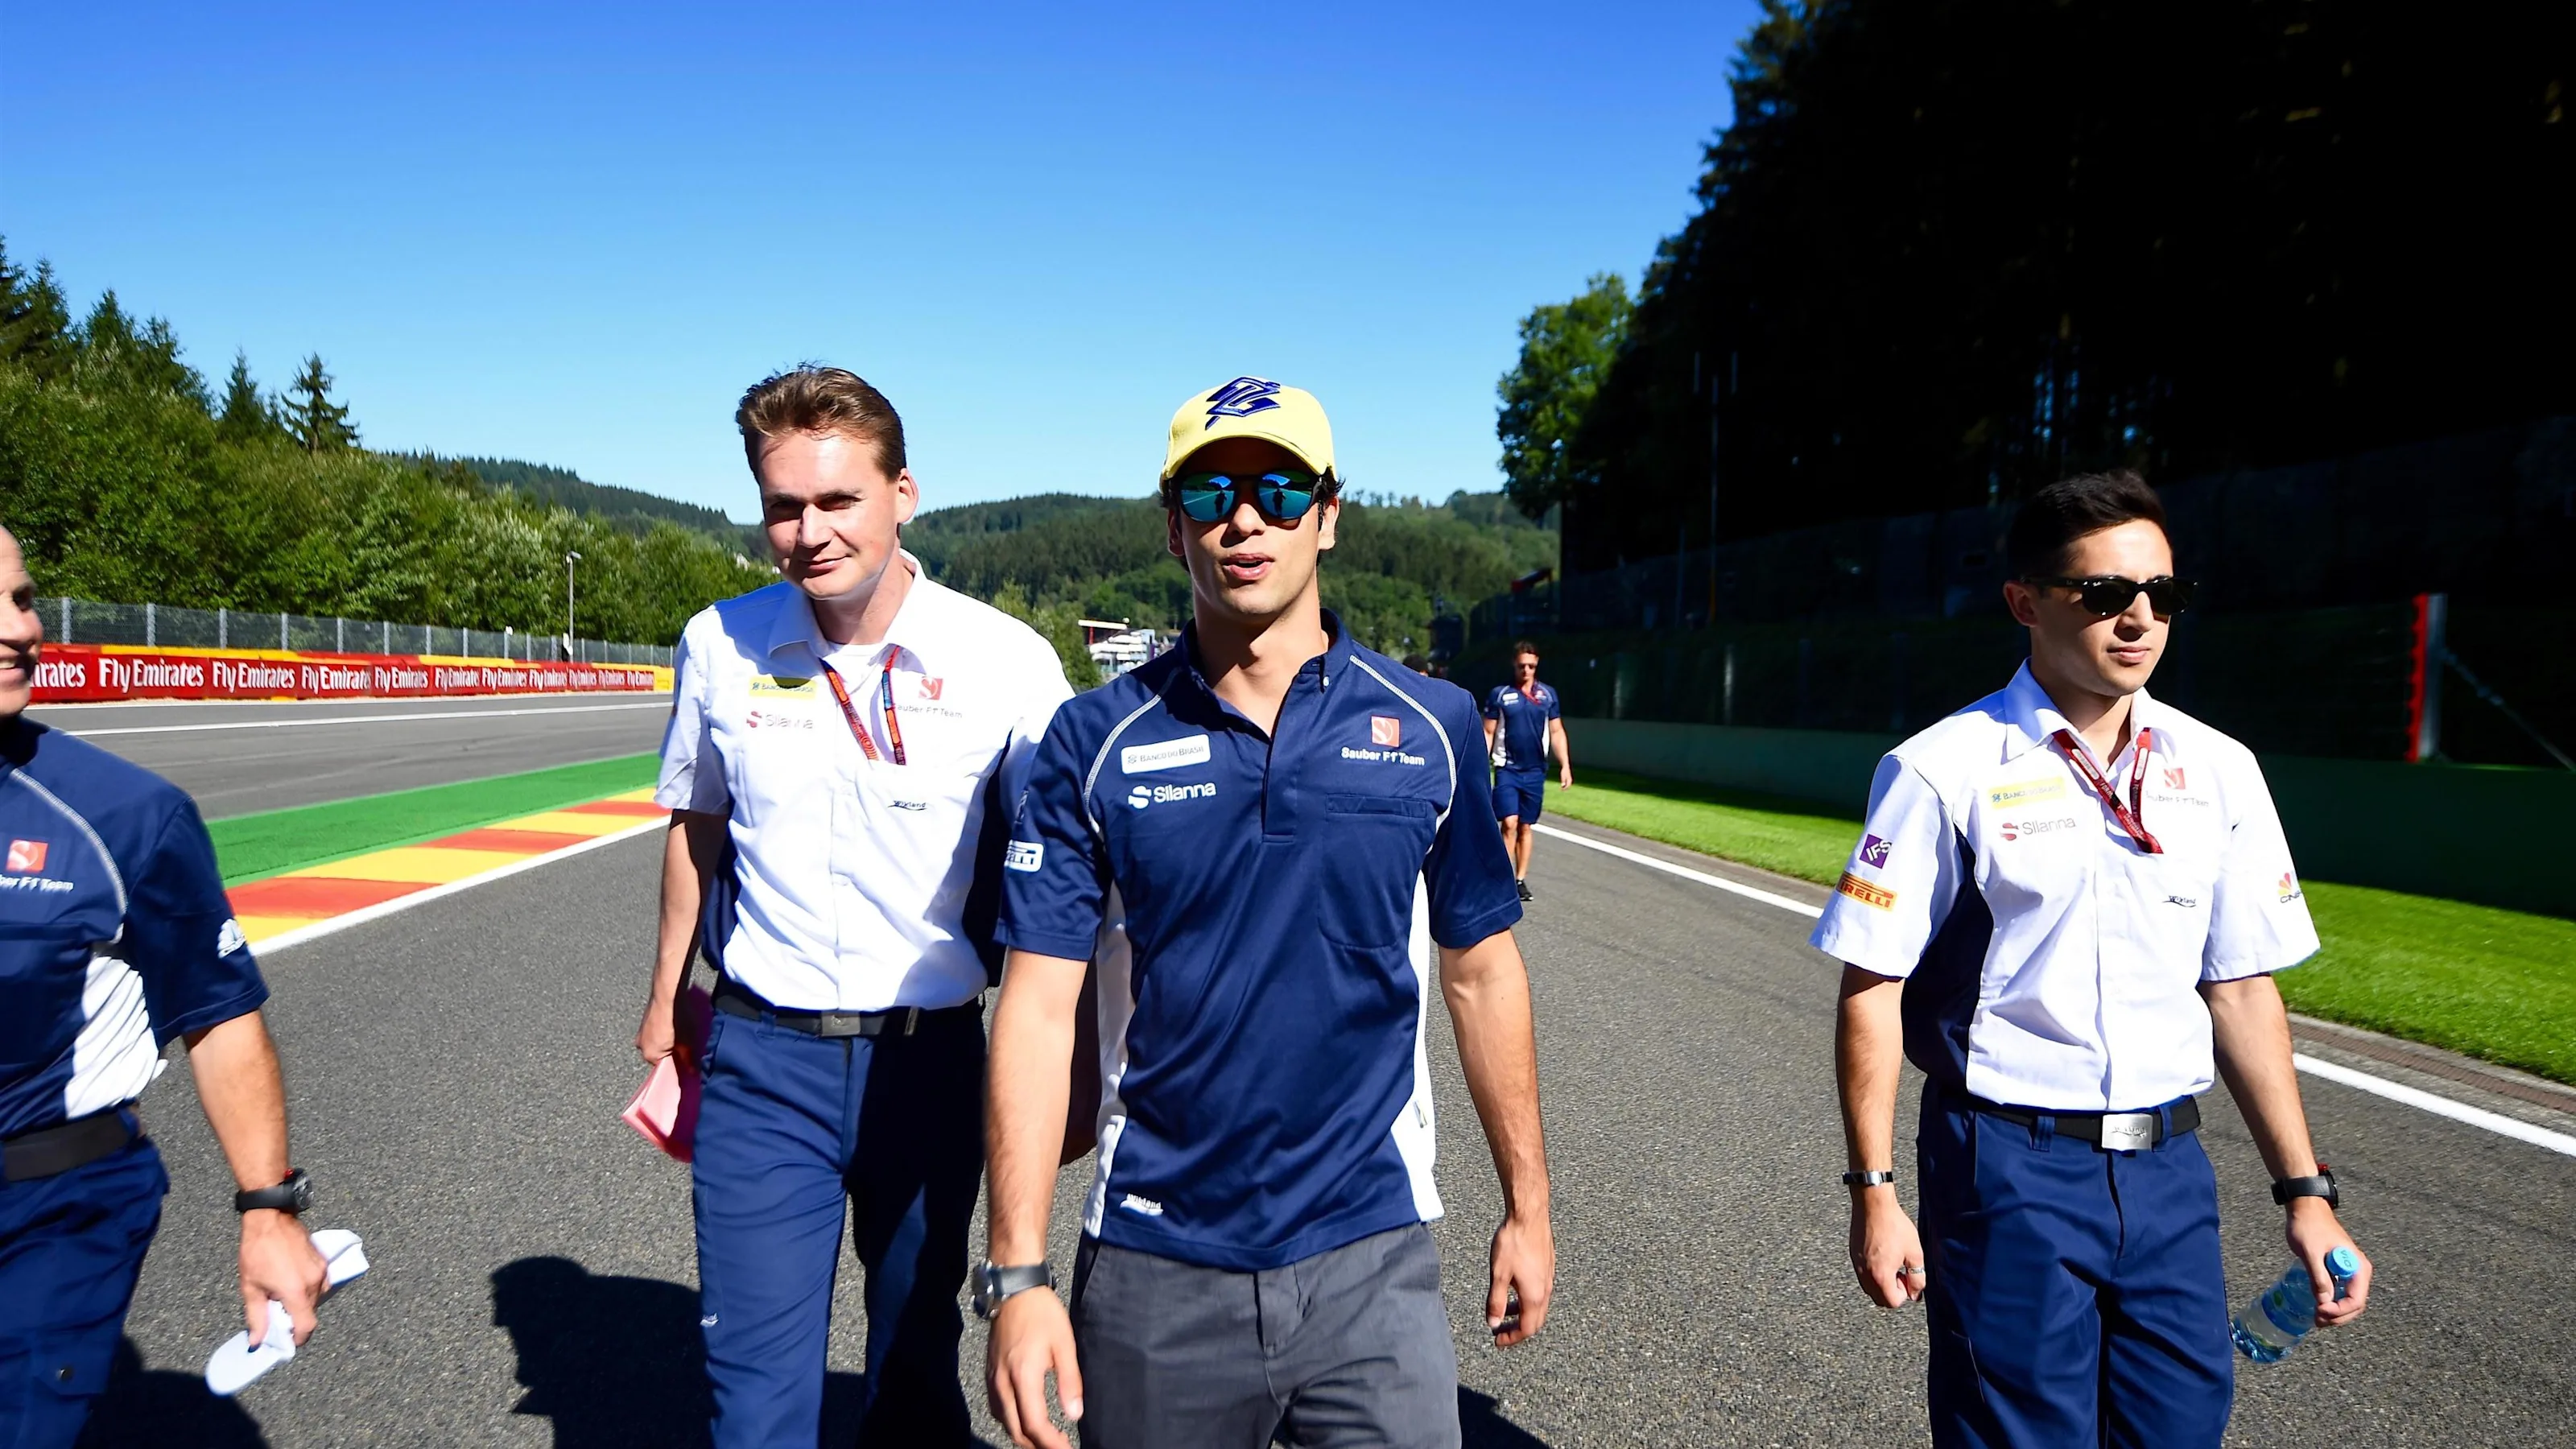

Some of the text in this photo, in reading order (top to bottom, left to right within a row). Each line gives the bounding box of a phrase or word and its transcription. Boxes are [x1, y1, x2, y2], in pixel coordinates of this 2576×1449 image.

[30, 658, 86, 687] irates
[98, 657, 204, 694] Fly Emirates
[213, 661, 295, 694] Fly Emirates
[301, 664, 371, 695] Fly Emirates
[374, 666, 428, 694] Fly Emirates
[435, 667, 448, 692] Fly
[482, 667, 497, 691] Fly
[529, 668, 543, 691] Fly
[898, 704, 924, 713] auber
[1140, 752, 1166, 762] BANCO
[1179, 745, 1204, 757] BRASIL
[1341, 746, 1426, 766] Sauber F1 Team
[1153, 782, 1217, 803] Silanna
[2022, 817, 2076, 835] Silanna
[1866, 840, 1893, 861] IFS
[39, 878, 74, 894] Team
